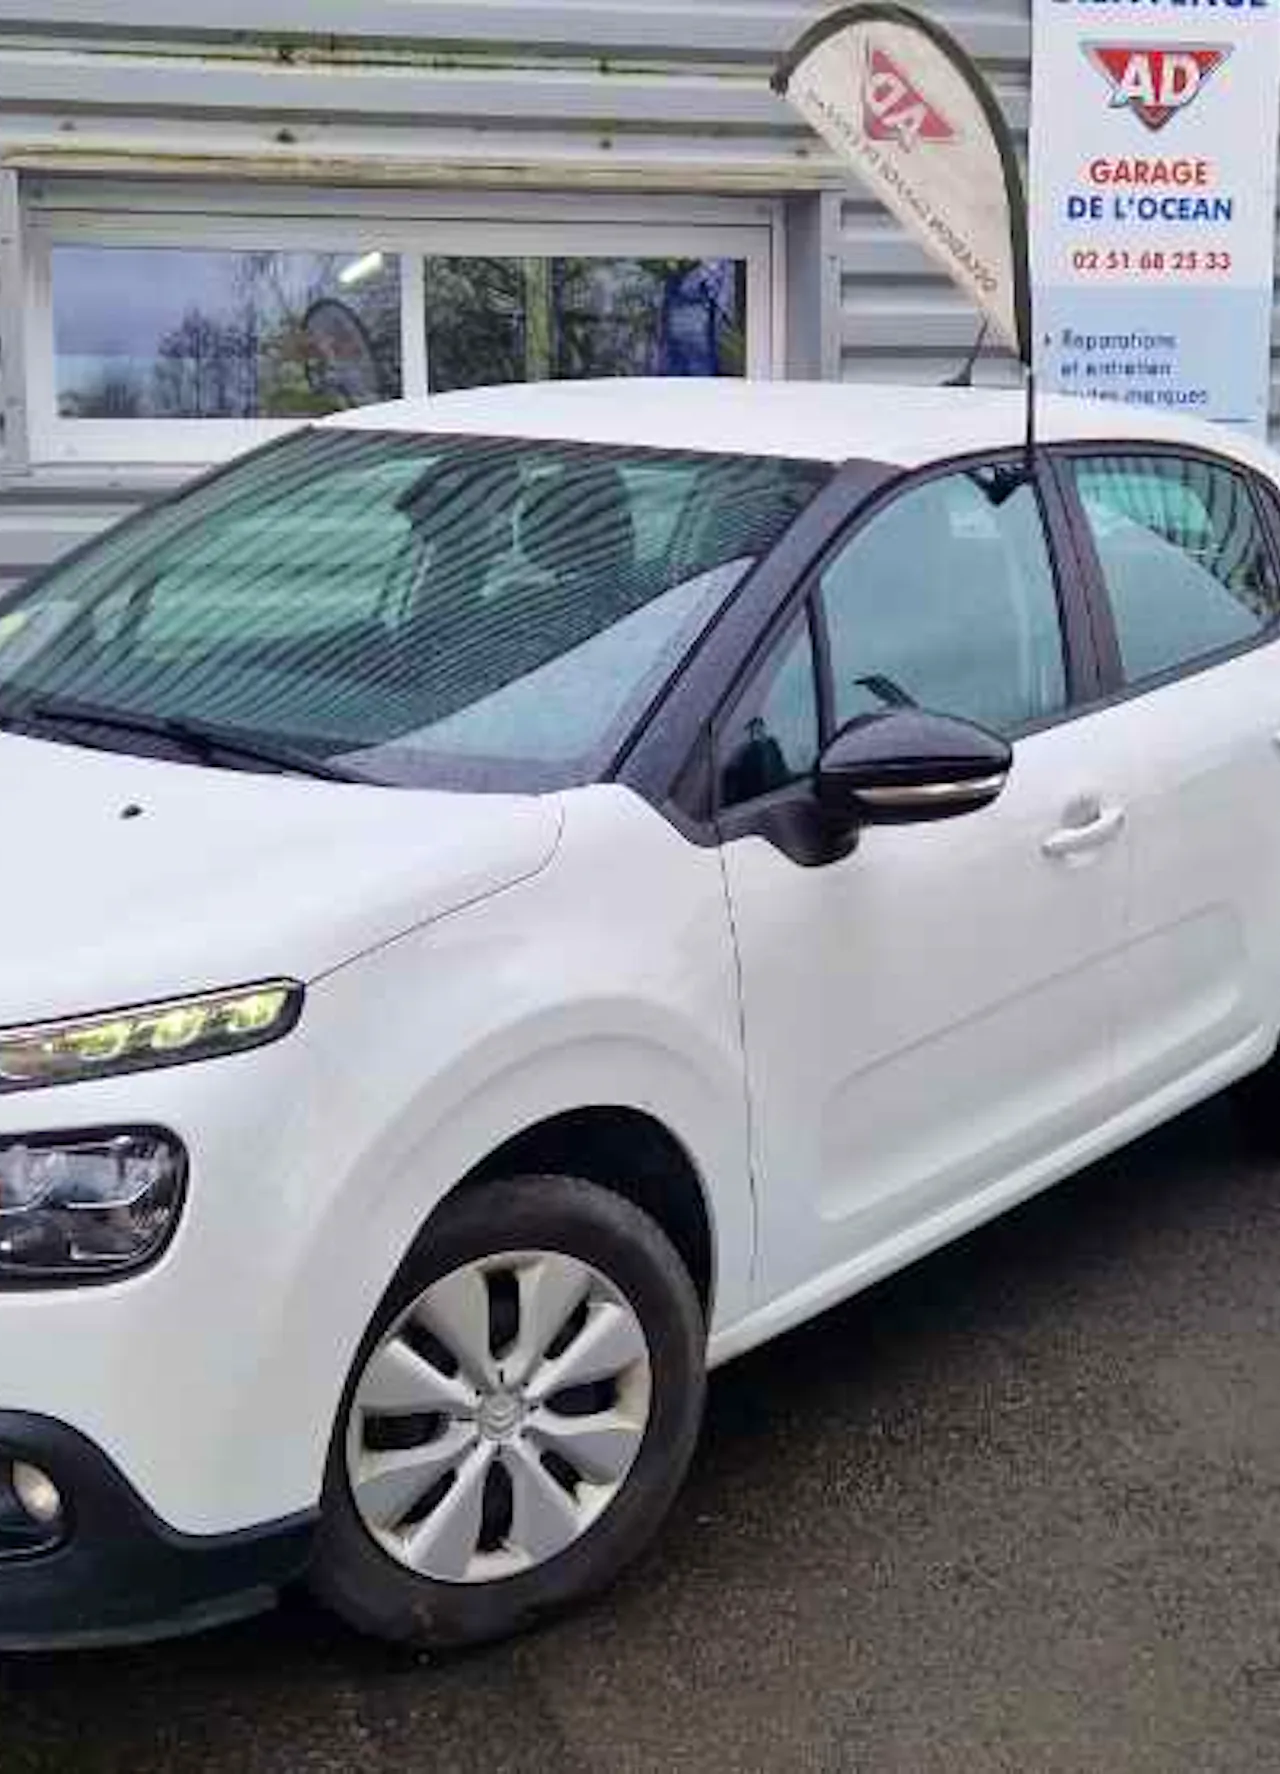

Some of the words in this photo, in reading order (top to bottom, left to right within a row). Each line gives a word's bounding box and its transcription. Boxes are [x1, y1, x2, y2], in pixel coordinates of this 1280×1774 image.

[1112, 52, 1202, 107] AD
[1089, 159, 1208, 185] GARAGE
[1067, 197, 1103, 220] DE
[1114, 198, 1233, 221] L'OCEAN
[1073, 252, 1098, 270] 02
[1107, 252, 1131, 270] 51
[1172, 252, 1197, 270] 25
[1205, 252, 1231, 270] 33
